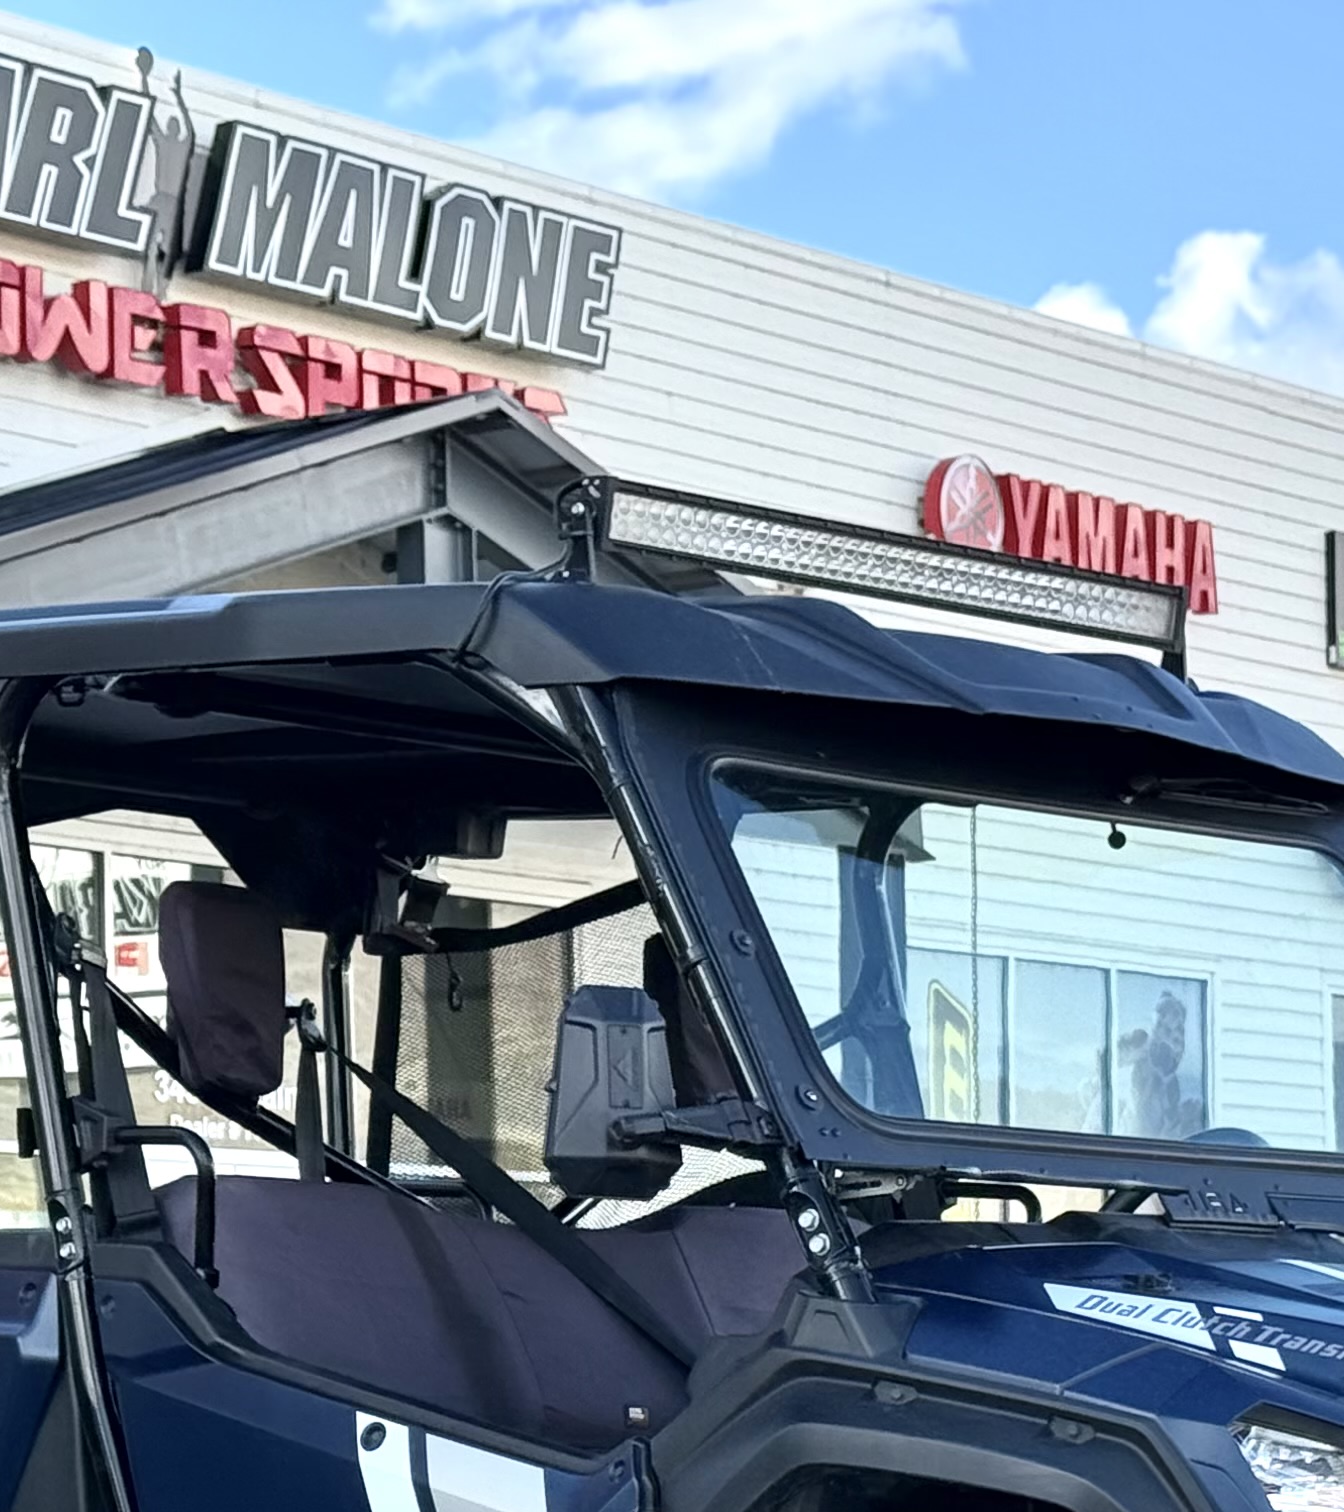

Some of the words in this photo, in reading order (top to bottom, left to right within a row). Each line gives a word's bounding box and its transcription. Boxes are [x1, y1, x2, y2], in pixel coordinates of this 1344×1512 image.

[200, 122, 623, 367] MALONE
[1000, 474, 1218, 614] YAMAHA
[1074, 1294, 1154, 1319] Dual
[1150, 1307, 1252, 1338] Clutch
